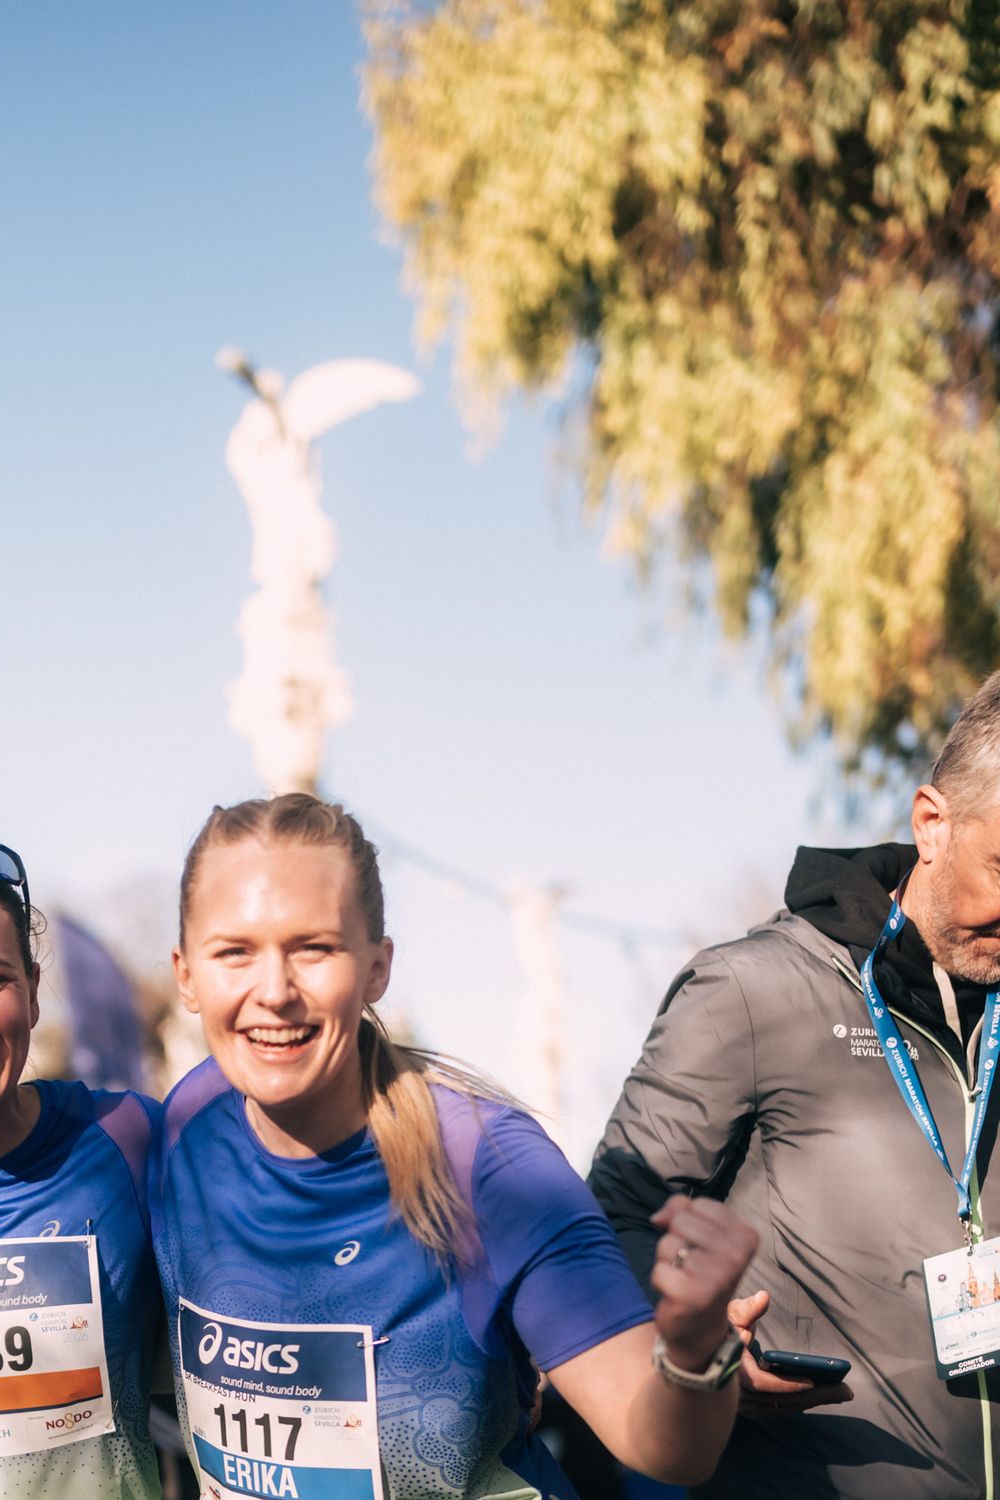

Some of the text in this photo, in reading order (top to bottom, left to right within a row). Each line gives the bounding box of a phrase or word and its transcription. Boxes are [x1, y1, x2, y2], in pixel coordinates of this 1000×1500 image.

[850, 1027, 878, 1037] ZURI
[850, 1047, 885, 1057] SEVILL
[891, 1048, 909, 1078] ZURICH
[921, 1115, 938, 1147] SEVILLA
[21, 1292, 48, 1307] body
[948, 1358, 995, 1377] ORGANIZADOR
[220, 1375, 322, 1398] sound mind, sound body
[234, 1390, 256, 1403] RUN
[213, 1403, 303, 1462] 1117
[222, 1453, 300, 1499] ERIKA
